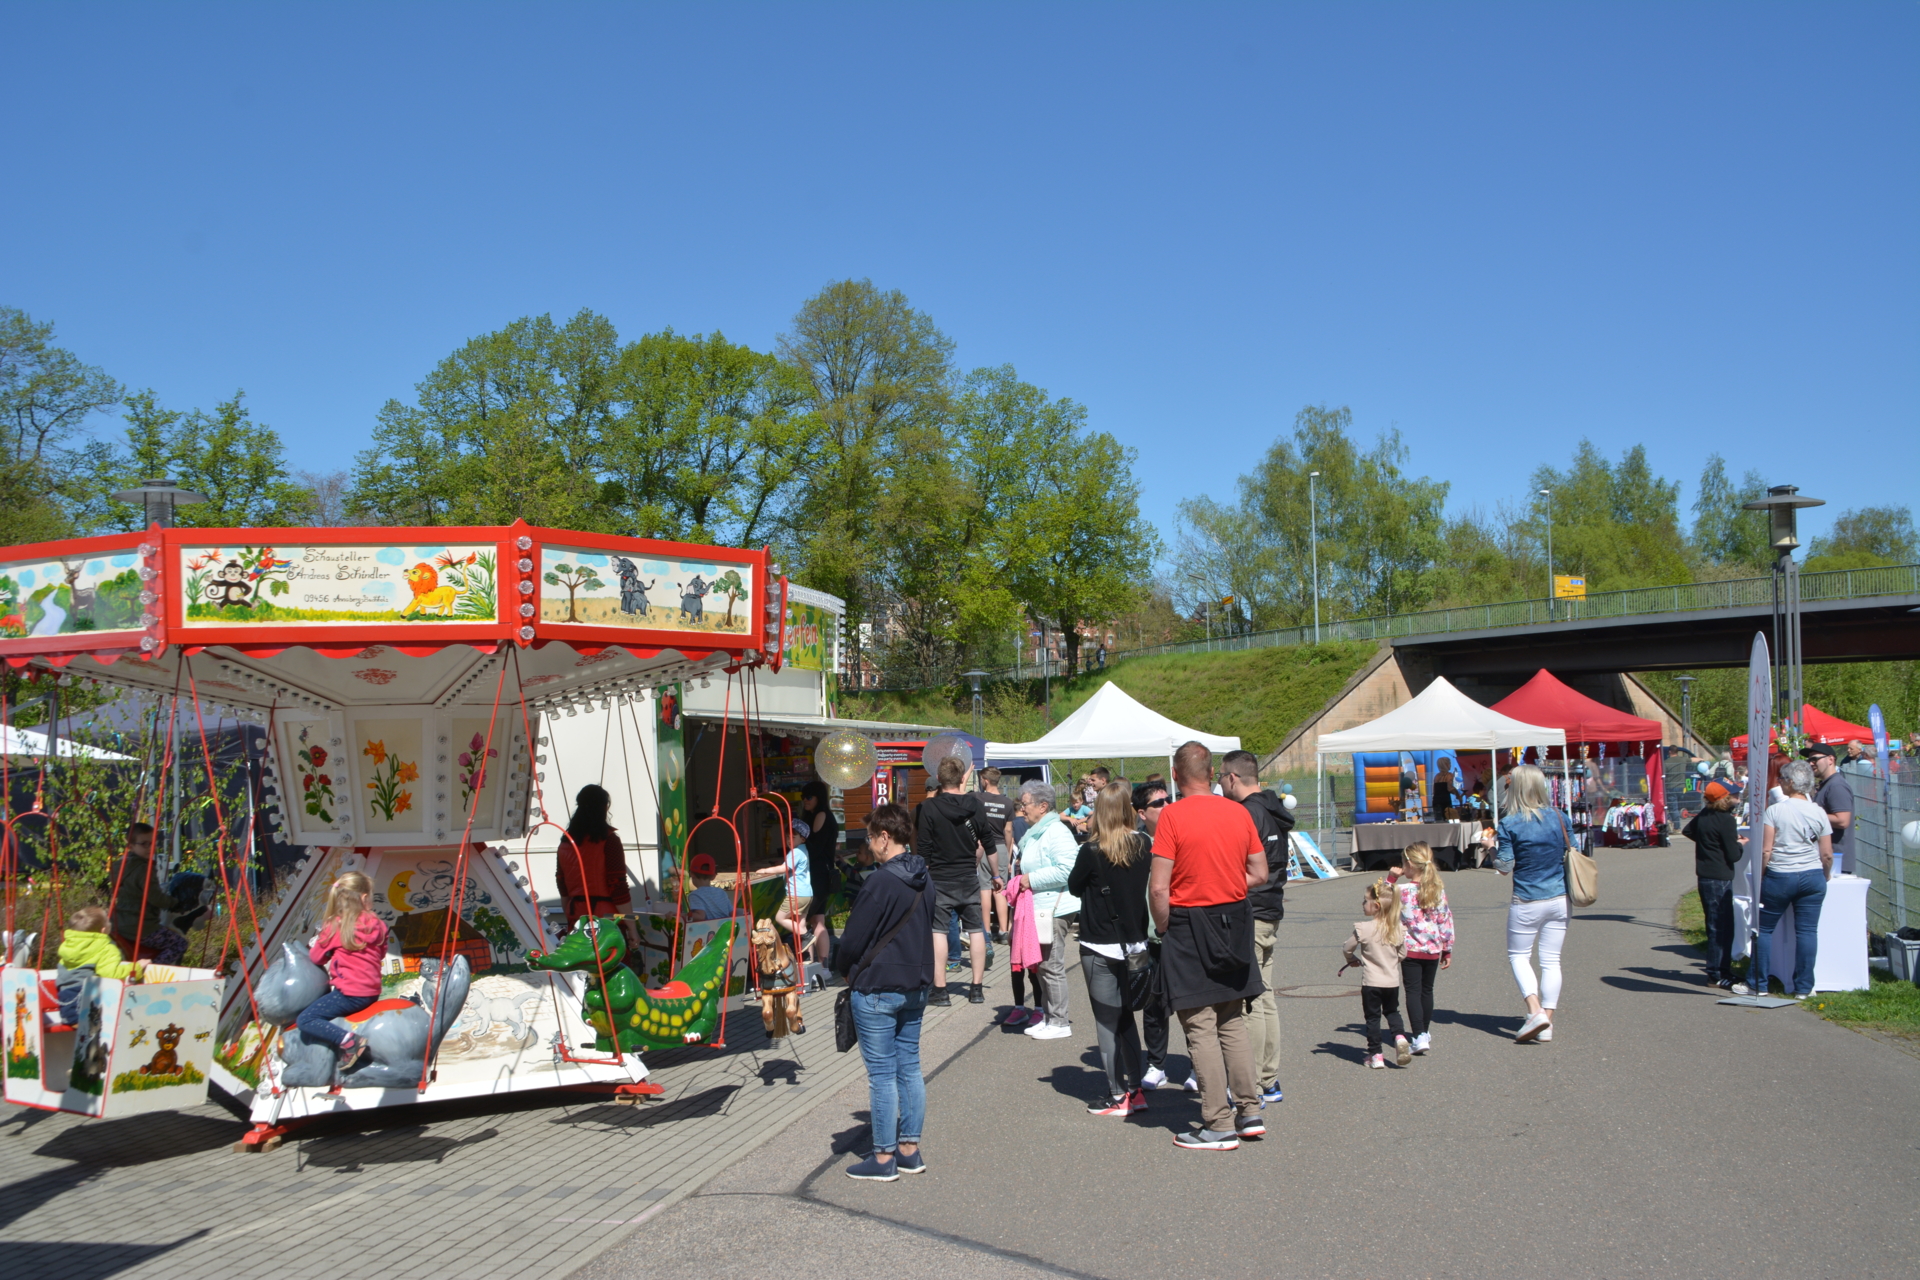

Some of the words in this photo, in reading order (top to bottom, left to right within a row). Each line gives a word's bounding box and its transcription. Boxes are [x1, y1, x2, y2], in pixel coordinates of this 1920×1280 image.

[303, 546, 370, 562] Schausteller
[335, 563, 390, 580] Schindler
[304, 594, 329, 602] 09456
